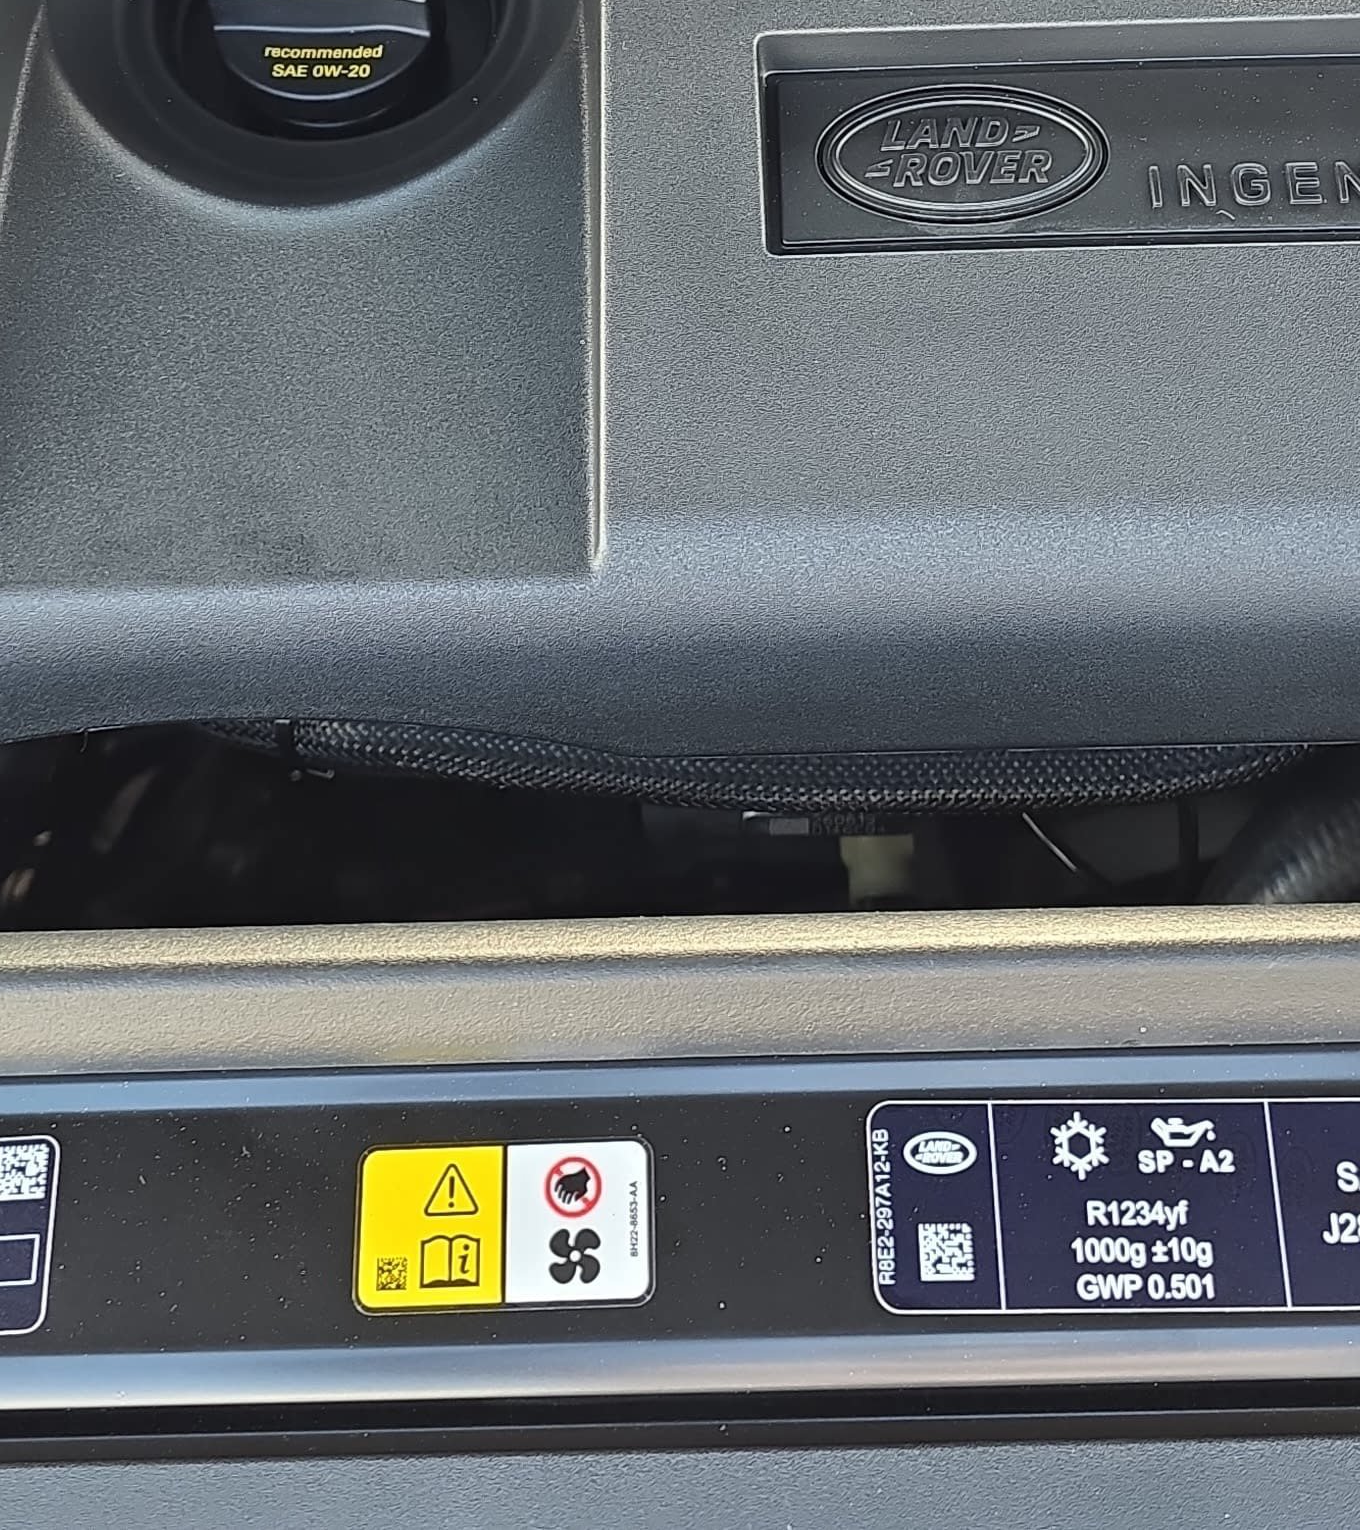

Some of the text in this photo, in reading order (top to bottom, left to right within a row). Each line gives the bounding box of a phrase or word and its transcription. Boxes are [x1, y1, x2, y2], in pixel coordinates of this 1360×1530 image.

[264, 44, 383, 59] recommended
[271, 63, 371, 78] SAE 0W-20
[880, 115, 1010, 152] LAND
[892, 150, 1053, 188] ROVER
[1138, 1149, 1175, 1174] SP
[1199, 1149, 1236, 1173] A2
[871, 1128, 896, 1285] R8E2-297A12-KB
[1086, 1199, 1189, 1231] R1234yf
[1071, 1236, 1214, 1268] 1000g ±10g
[1076, 1272, 1215, 1300] GWP 0.501
